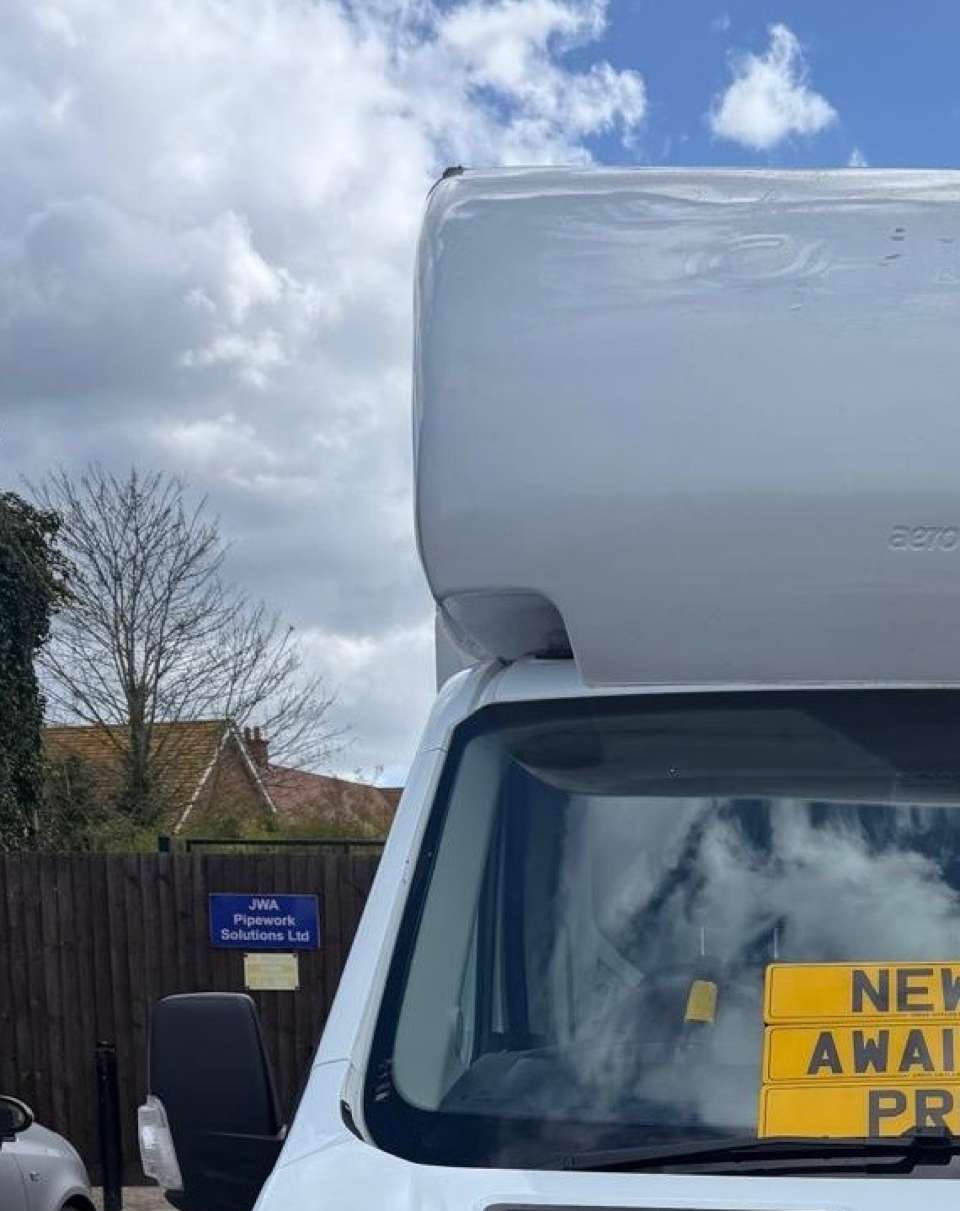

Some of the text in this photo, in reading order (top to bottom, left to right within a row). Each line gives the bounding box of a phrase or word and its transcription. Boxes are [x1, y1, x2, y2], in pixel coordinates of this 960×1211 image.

[248, 898, 280, 911] JWA
[233, 913, 296, 927] Pipework
[220, 928, 310, 943] Solutions Ltd
